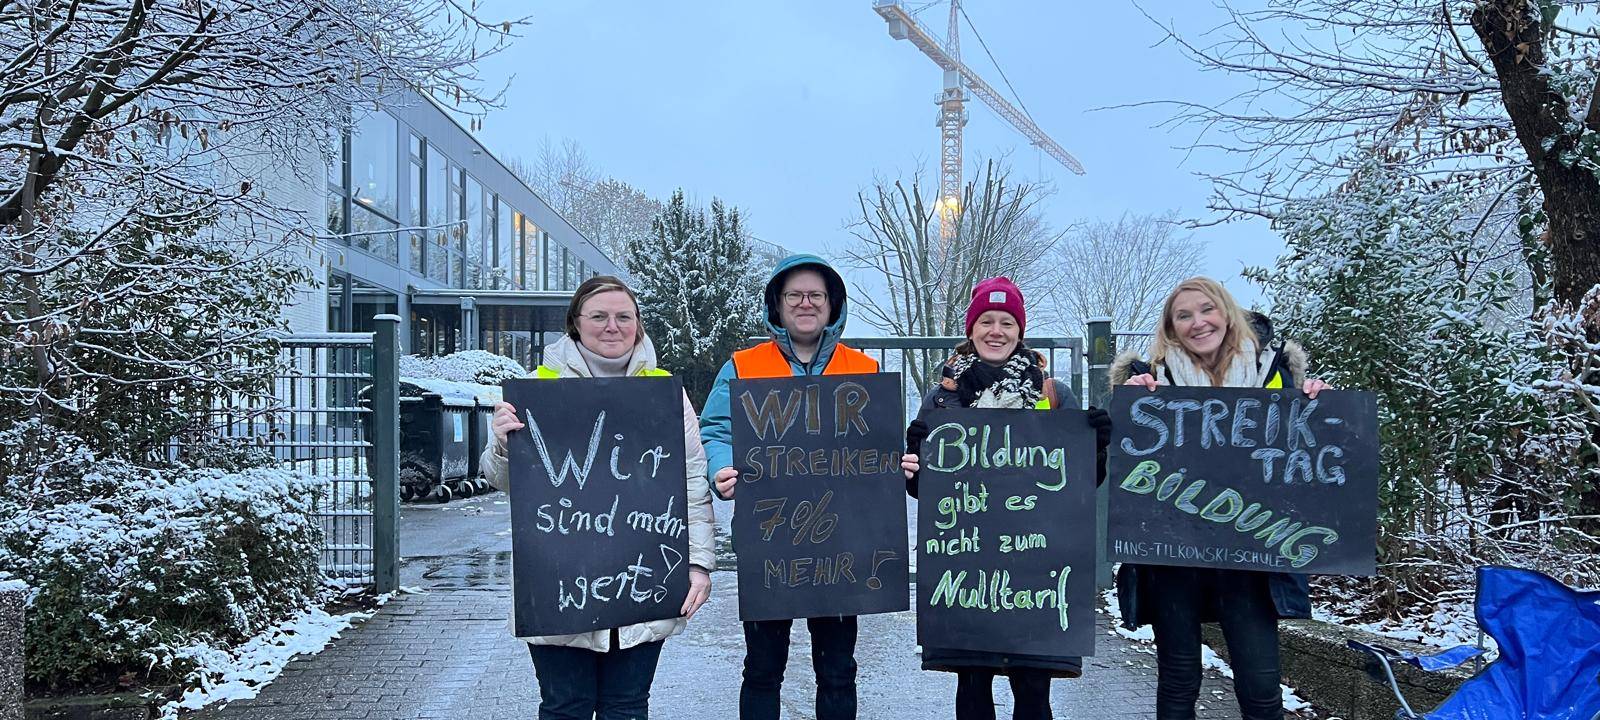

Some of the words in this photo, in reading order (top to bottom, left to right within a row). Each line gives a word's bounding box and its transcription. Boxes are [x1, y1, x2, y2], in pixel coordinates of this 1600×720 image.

[739, 382, 871, 441] WIR
[525, 408, 670, 489] Wir
[743, 446, 901, 483] STREIKEN
[925, 422, 1067, 491] Bildung
[1251, 445, 1346, 486] TAG
[536, 494, 619, 536] sind
[753, 489, 838, 546] 7%
[935, 481, 989, 529] gibt
[1005, 495, 1038, 511] es
[926, 526, 980, 555] nicht
[999, 532, 1047, 553] zum
[929, 565, 1072, 632] Nulltarif
